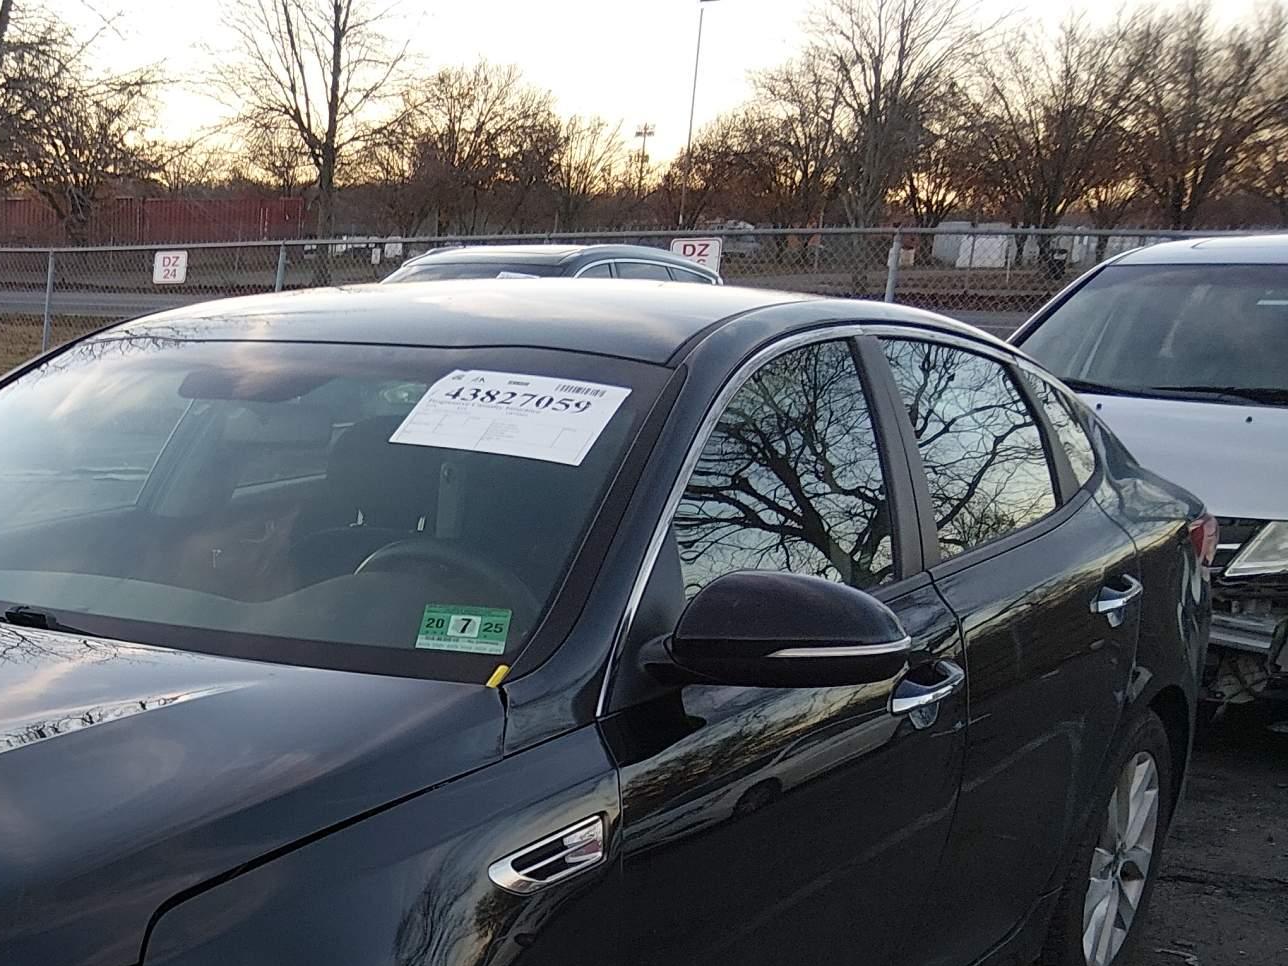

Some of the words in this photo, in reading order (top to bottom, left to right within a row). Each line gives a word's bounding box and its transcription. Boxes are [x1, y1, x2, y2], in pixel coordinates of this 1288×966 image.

[682, 243, 710, 257] DZ
[162, 256, 180, 267] DZ
[162, 268, 177, 280] 24
[444, 386, 593, 414] 43827059
[425, 617, 445, 629] 20
[459, 617, 472, 634] 7
[482, 622, 505, 634] 25
